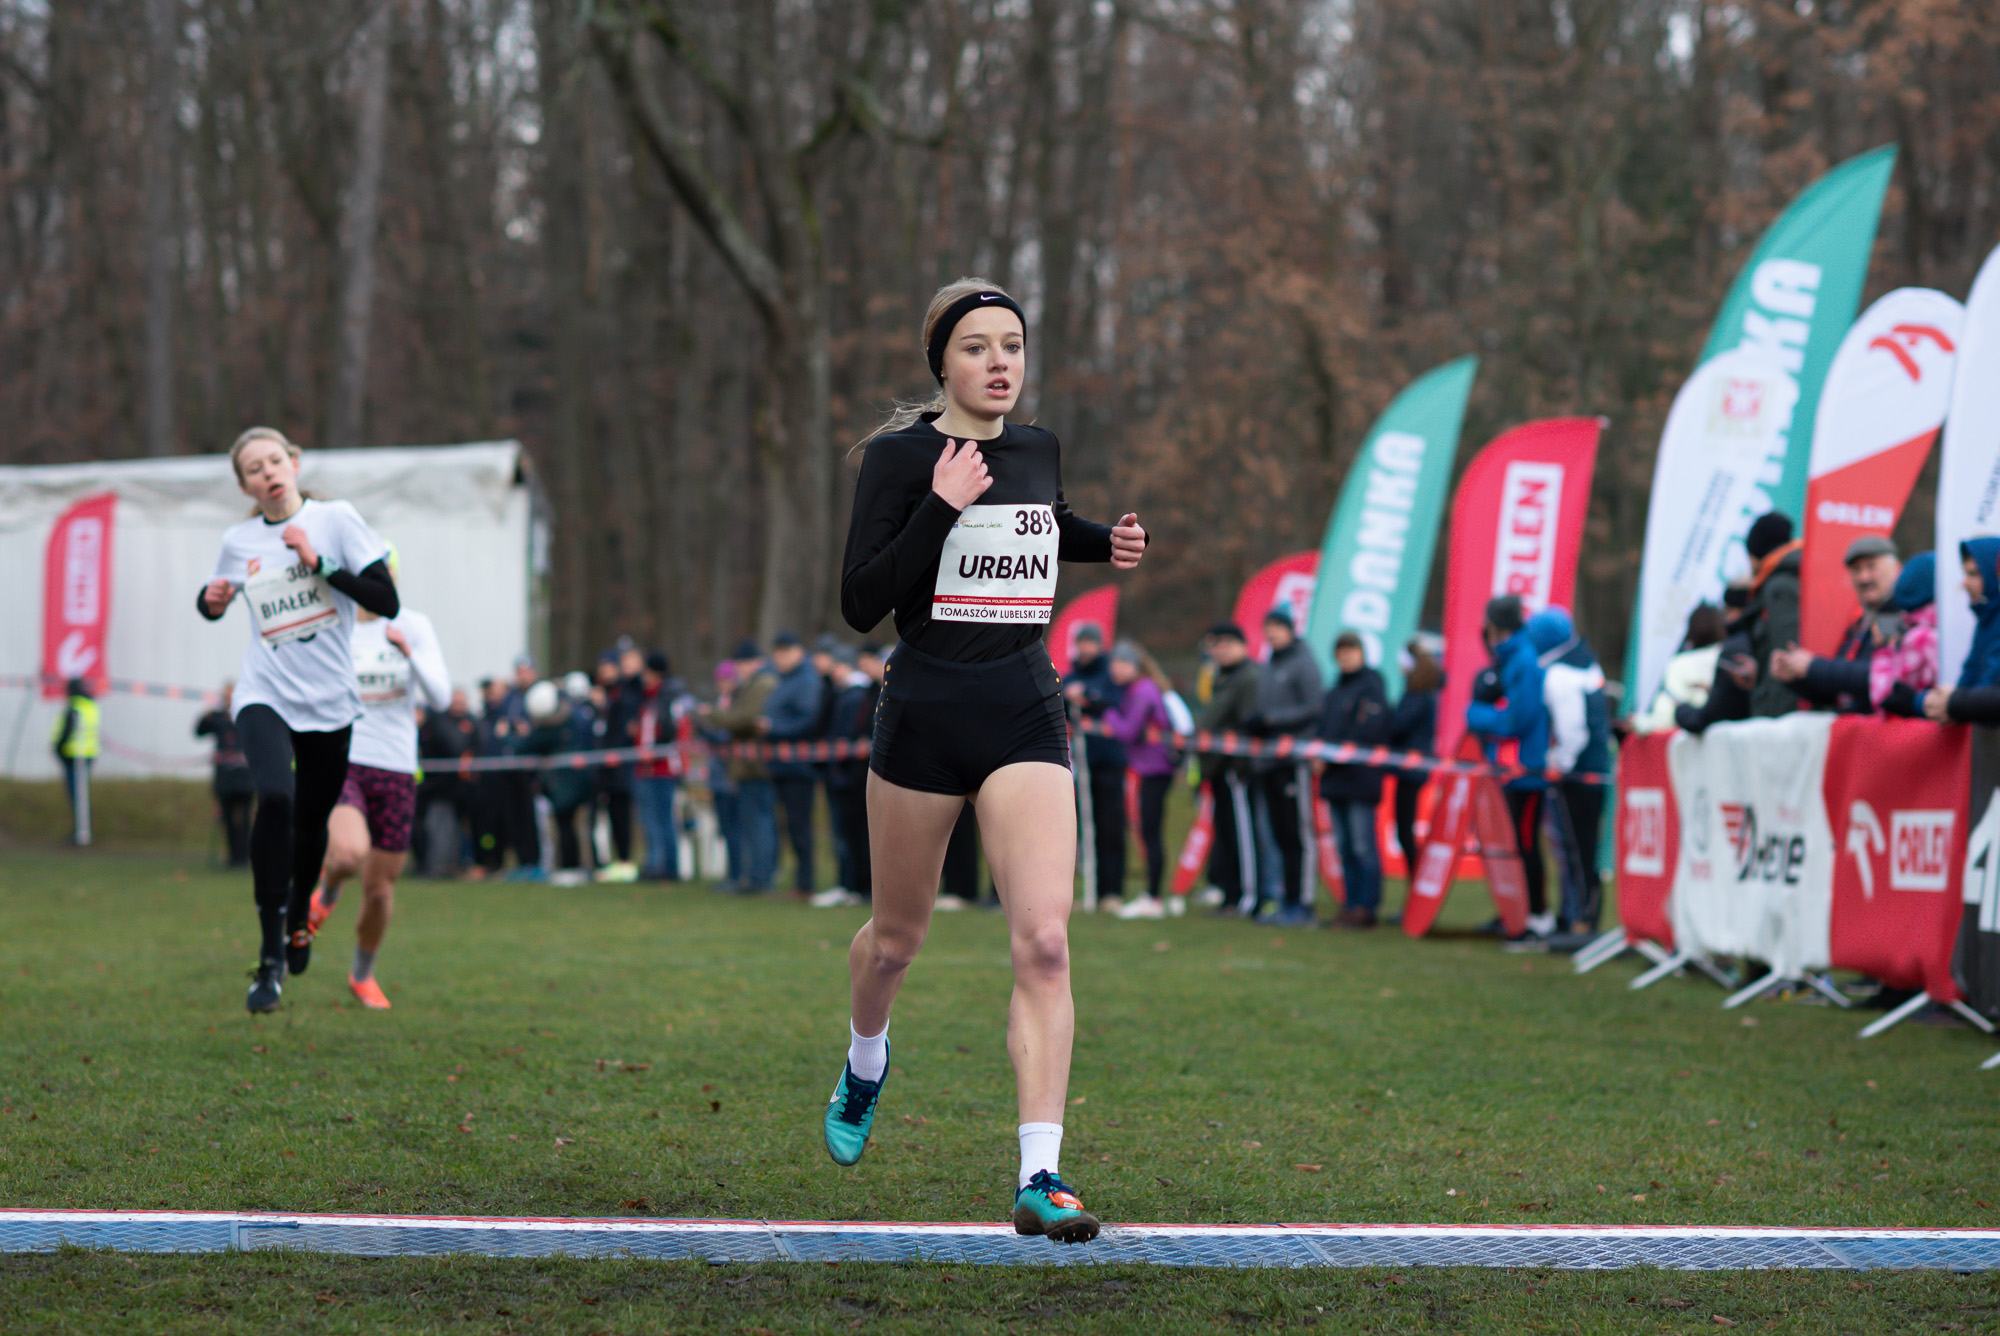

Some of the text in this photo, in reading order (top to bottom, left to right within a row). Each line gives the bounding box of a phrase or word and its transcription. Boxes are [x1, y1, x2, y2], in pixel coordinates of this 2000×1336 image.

[1015, 510, 1052, 535] 389
[1817, 500, 1894, 528] ORLEN
[1506, 479, 1548, 614] RLEN
[286, 563, 316, 583] 38
[959, 555, 1048, 579] URBAN
[261, 587, 321, 618] BIAŁEK
[940, 607, 998, 619] TOMASZÓW
[1000, 609, 1036, 619] LUBELSKI
